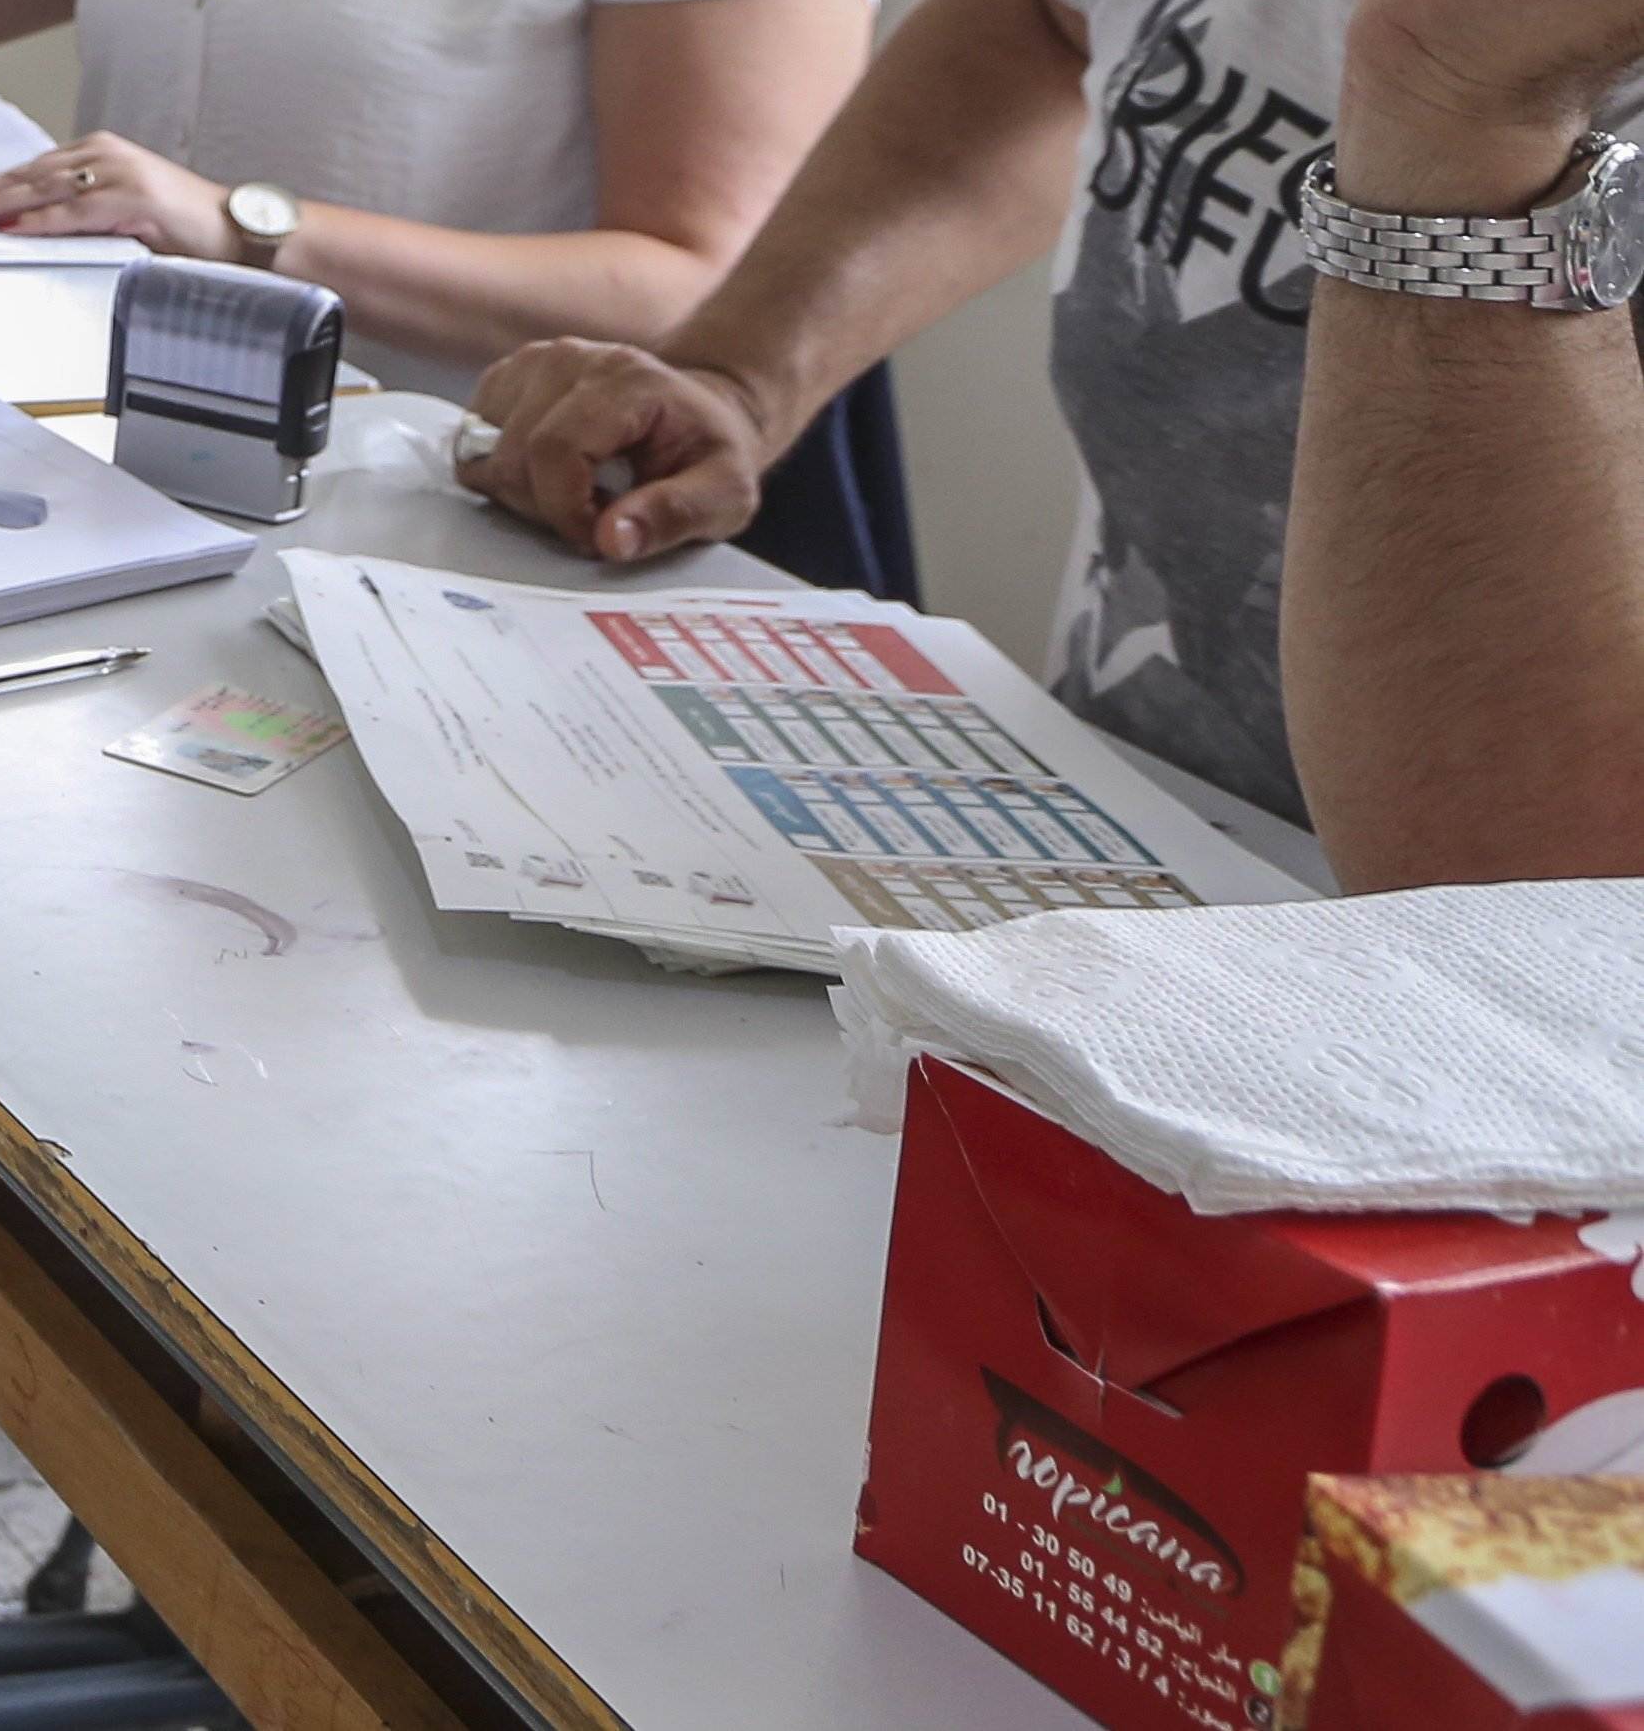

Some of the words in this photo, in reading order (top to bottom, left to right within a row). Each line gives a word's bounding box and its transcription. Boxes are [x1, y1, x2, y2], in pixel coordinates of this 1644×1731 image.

[982, 1491, 1008, 1523] 01
[1031, 1524, 1060, 1557] 30
[1067, 1548, 1096, 1580] 50
[1102, 1574, 1133, 1604] 49
[1020, 1550, 1045, 1581] 01
[1067, 1582, 1095, 1613] 55
[1100, 1607, 1128, 1635] 44
[1135, 1626, 1164, 1659] 52
[1032, 1591, 1058, 1622] 11
[1066, 1614, 1095, 1648] 62
[1116, 1647, 1131, 1672] 3
